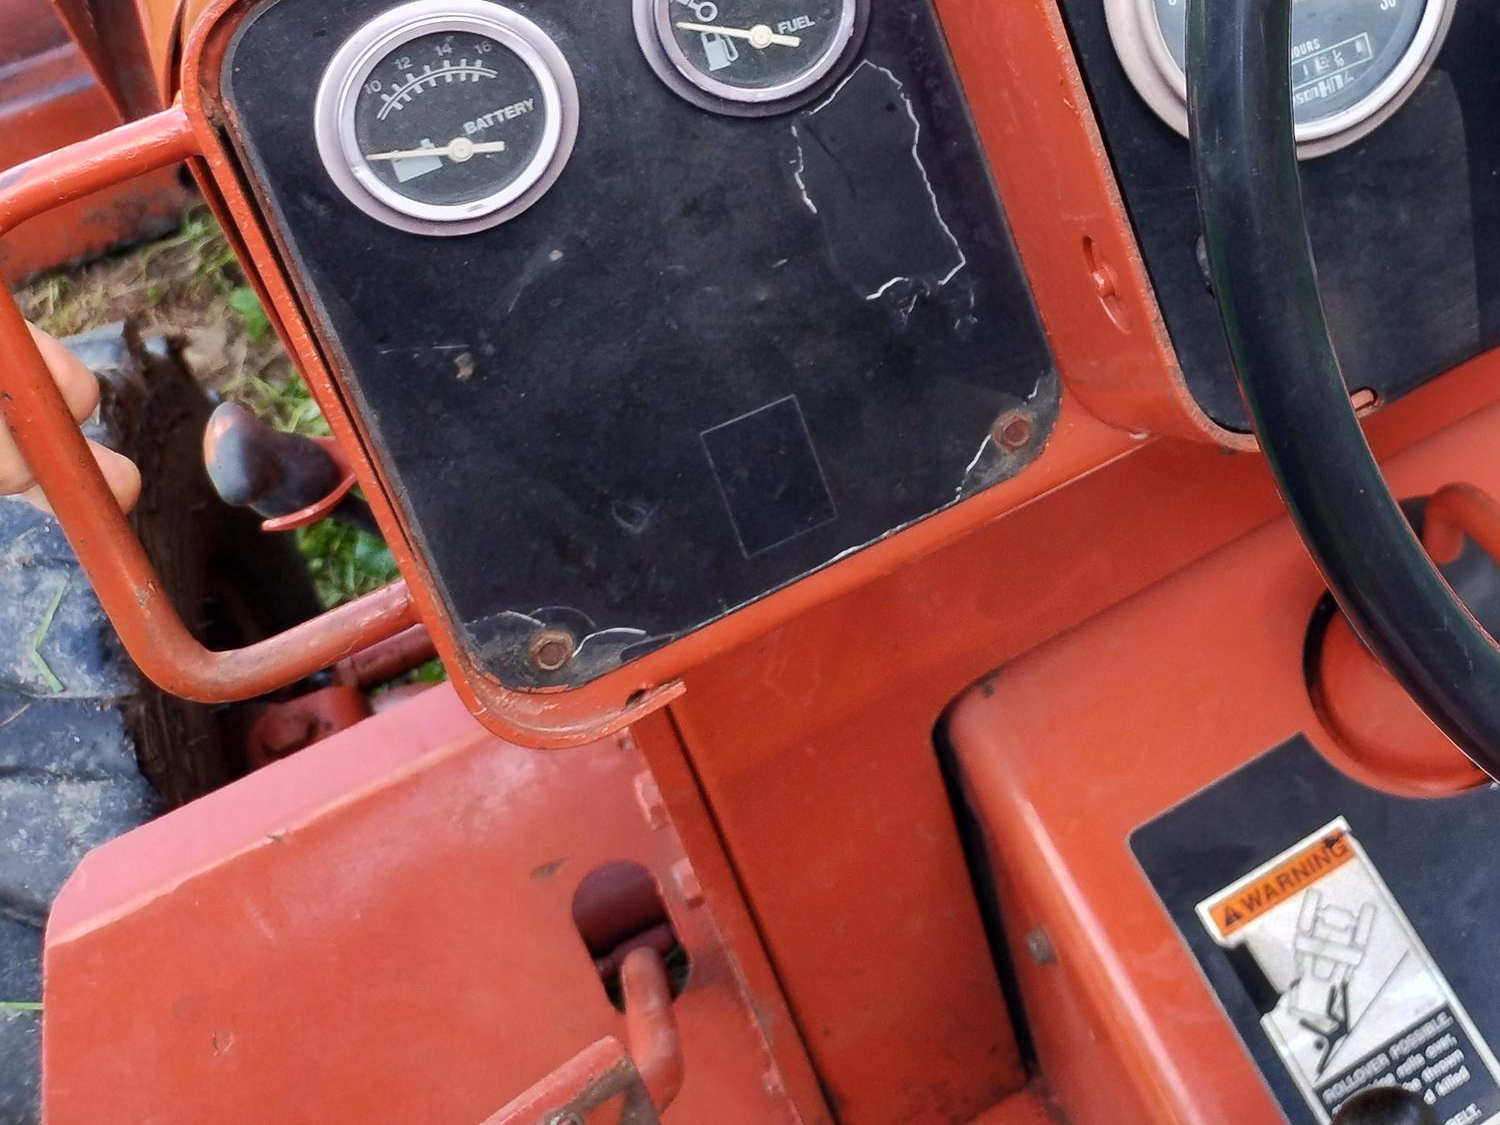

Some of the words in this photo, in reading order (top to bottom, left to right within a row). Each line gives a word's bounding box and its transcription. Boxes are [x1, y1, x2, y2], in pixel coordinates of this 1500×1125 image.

[777, 15, 816, 34] FUEL
[434, 42, 453, 57] 14
[474, 40, 493, 54] 16
[1292, 38, 1321, 59] OURS
[393, 56, 413, 70] 12
[364, 79, 383, 94] 10
[463, 98, 536, 135] BATTERY
[1241, 835, 1350, 912] WARNING
[1421, 1049, 1465, 1083] thrown
[1322, 1052, 1391, 1105] ROLLOVER
